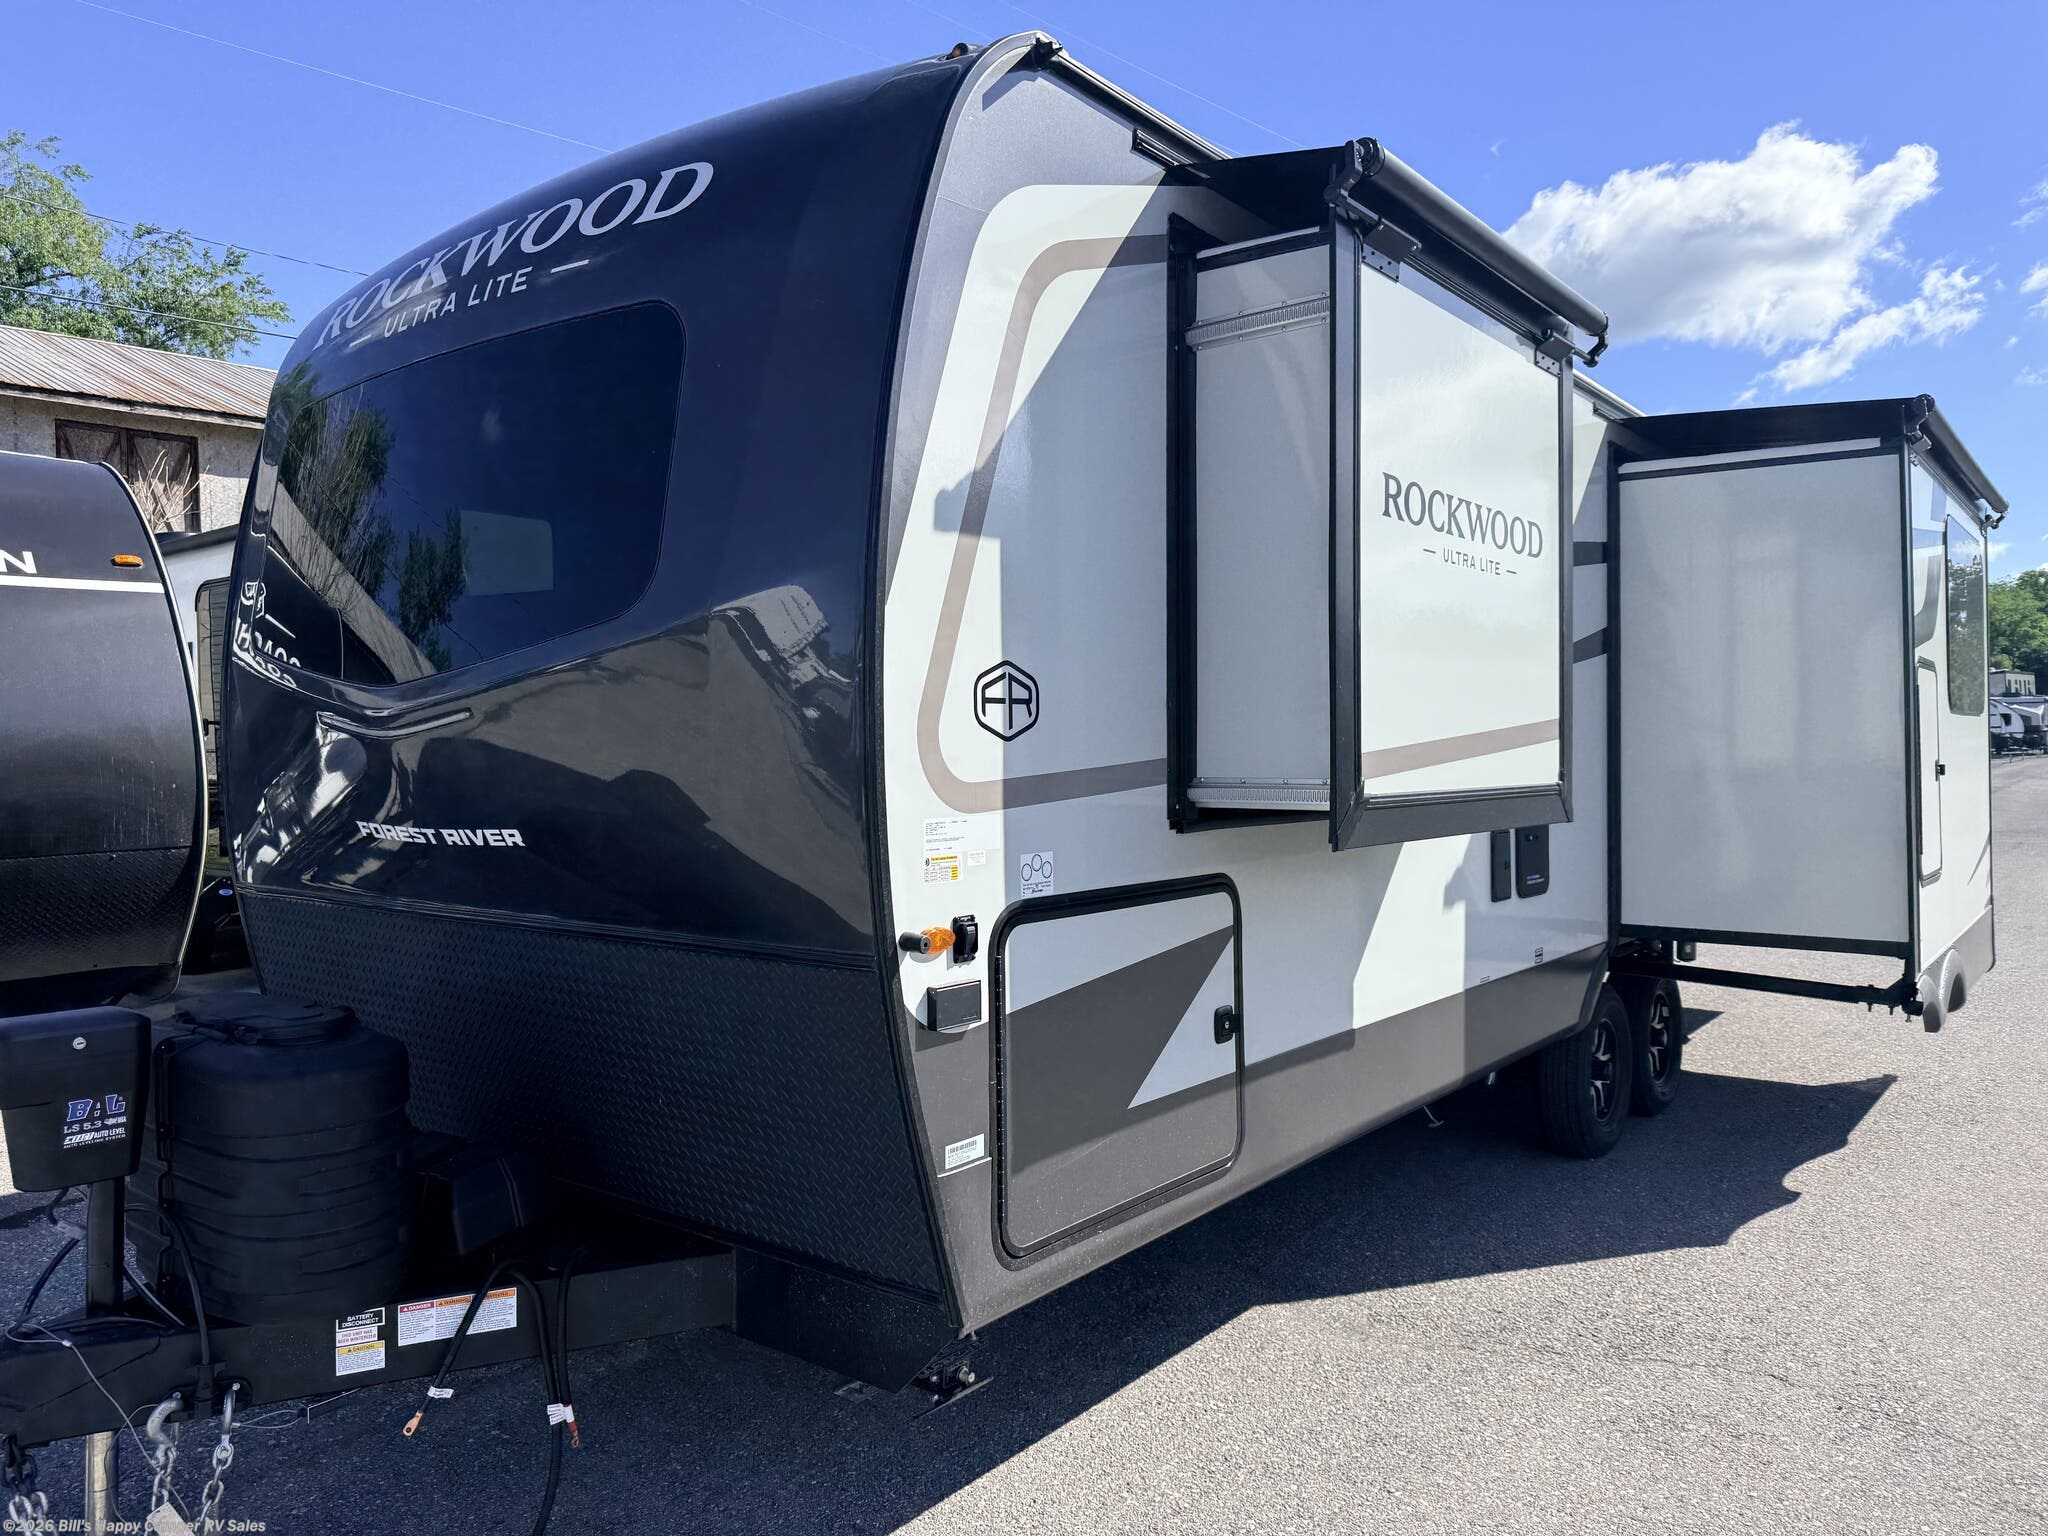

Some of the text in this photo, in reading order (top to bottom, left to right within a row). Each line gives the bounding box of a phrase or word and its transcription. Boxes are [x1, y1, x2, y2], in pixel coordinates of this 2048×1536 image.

[312, 161, 714, 352] ROCKWOOD
[384, 266, 533, 338] ULTRA LITE
[1382, 471, 1543, 559] ROCKWOOD
[1443, 547, 1501, 576] ULTRA LITE
[355, 820, 526, 847] FOREST RIVER
[64, 1120, 102, 1134] LS 5.3
[94, 1130, 109, 1139] AUTO
[109, 1127, 126, 1136] LEVEL
[341, 1317, 379, 1328] DISCONNECT
[347, 1313, 375, 1322] BATTERY
